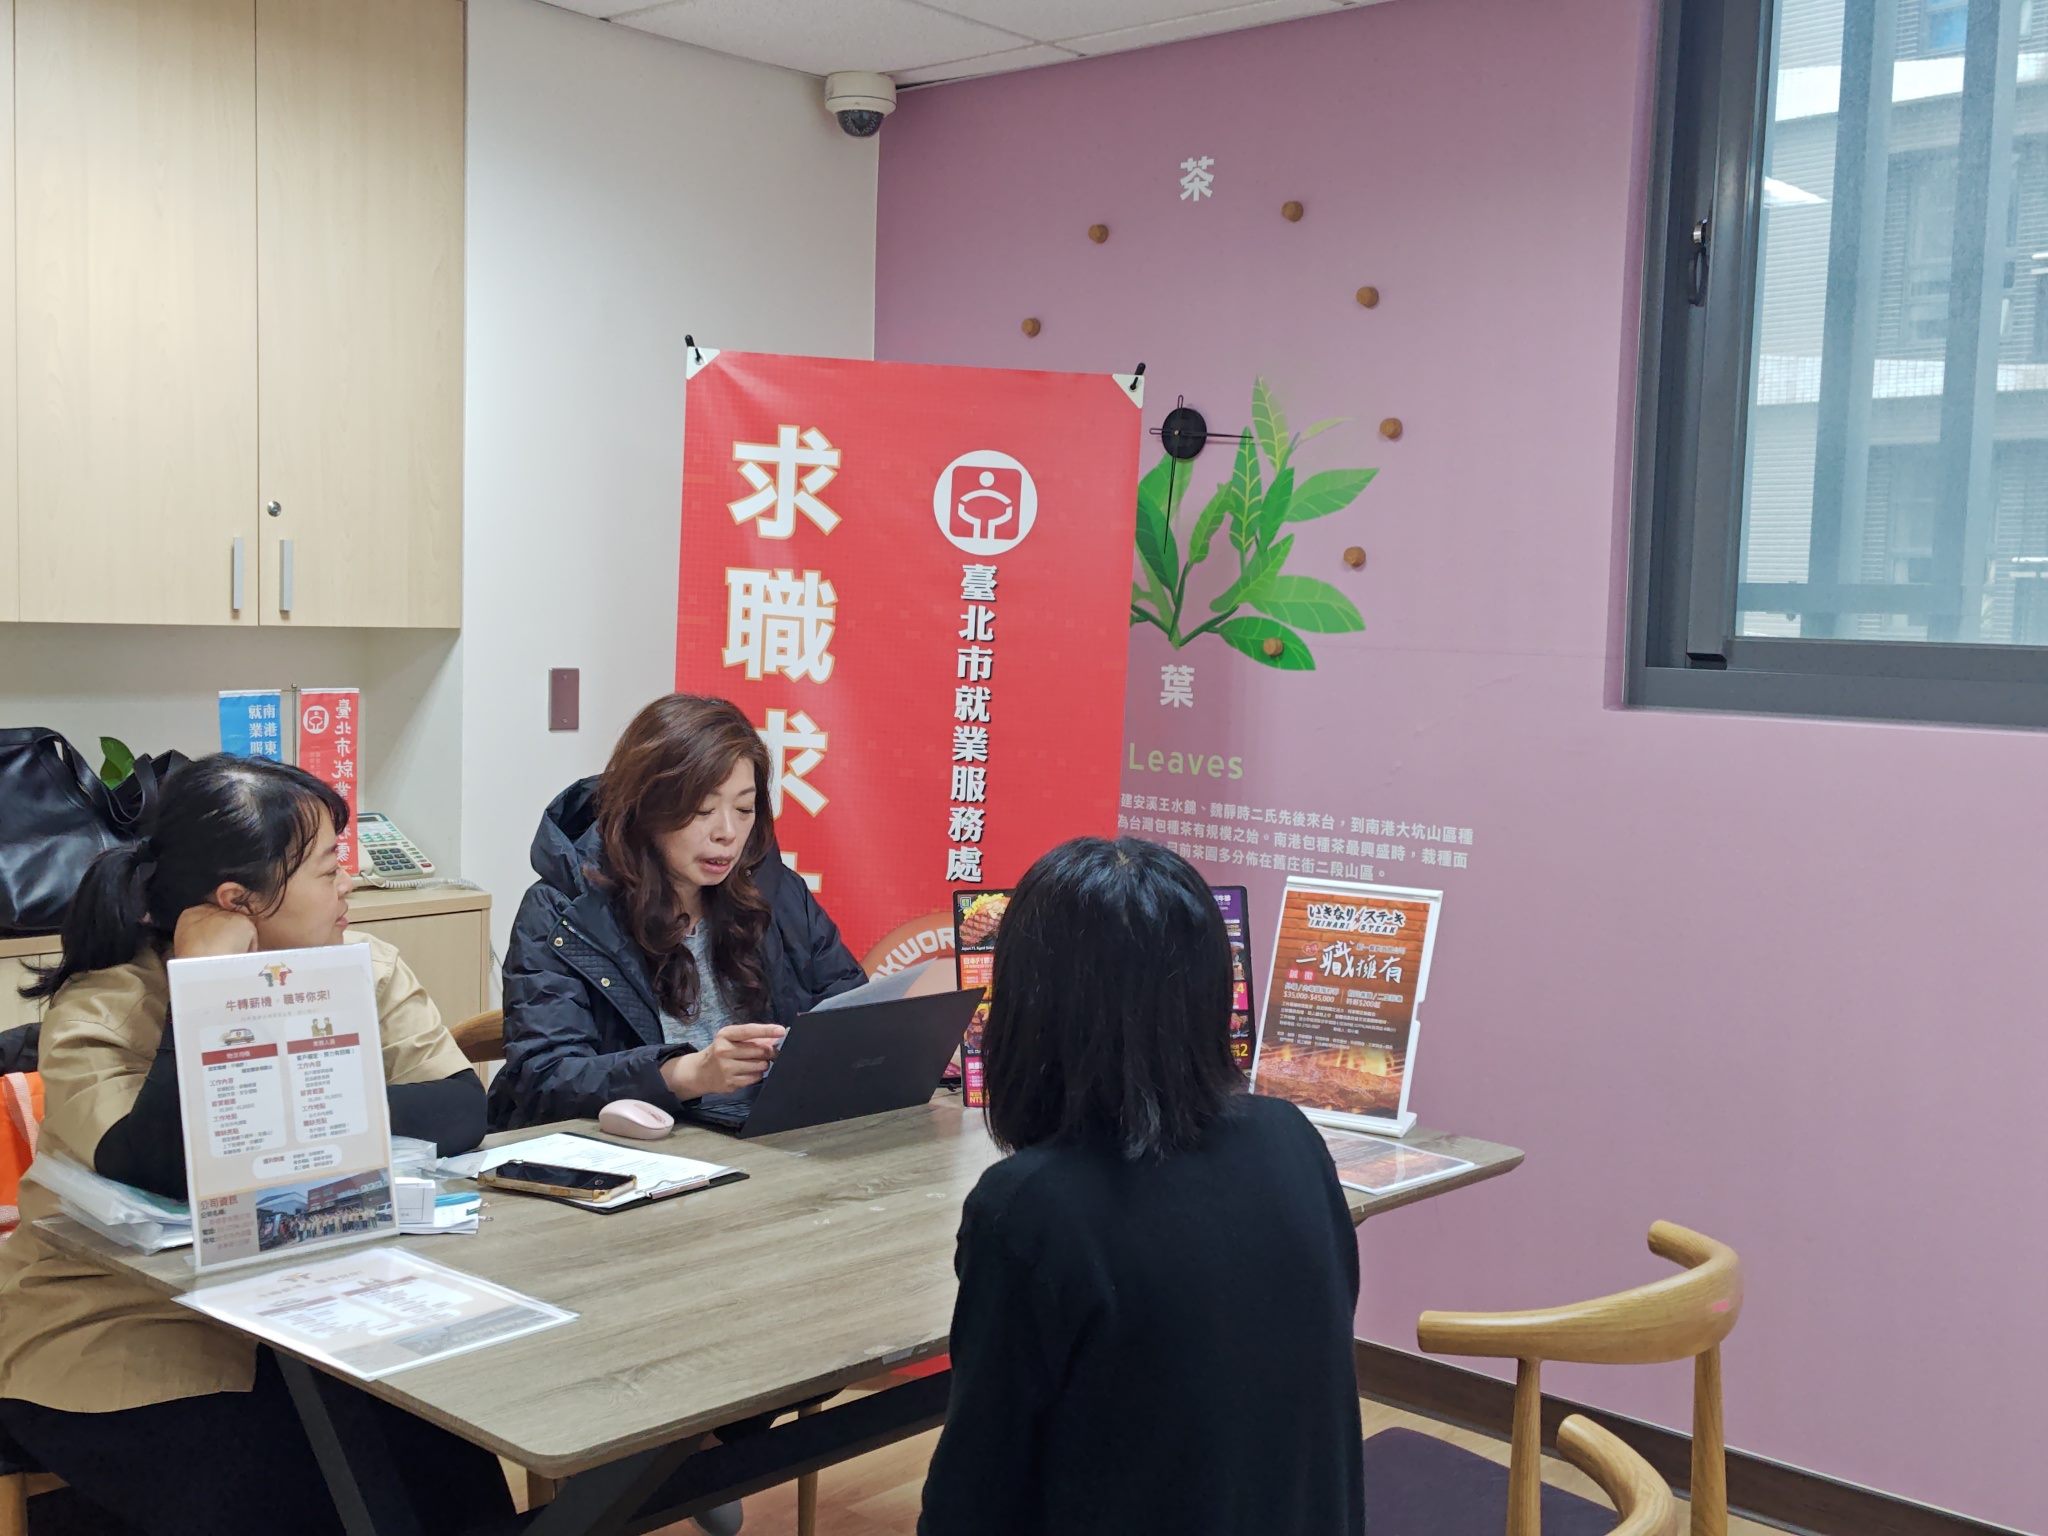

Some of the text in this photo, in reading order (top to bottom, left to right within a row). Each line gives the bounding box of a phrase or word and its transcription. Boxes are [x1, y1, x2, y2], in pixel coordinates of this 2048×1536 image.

[1180, 156, 1215, 202] 茶
[1160, 664, 1195, 708] 葉
[946, 563, 998, 883] 臺北市就業服務處
[1129, 742, 1245, 780] Leaves
[1360, 924, 1397, 934] STEAK
